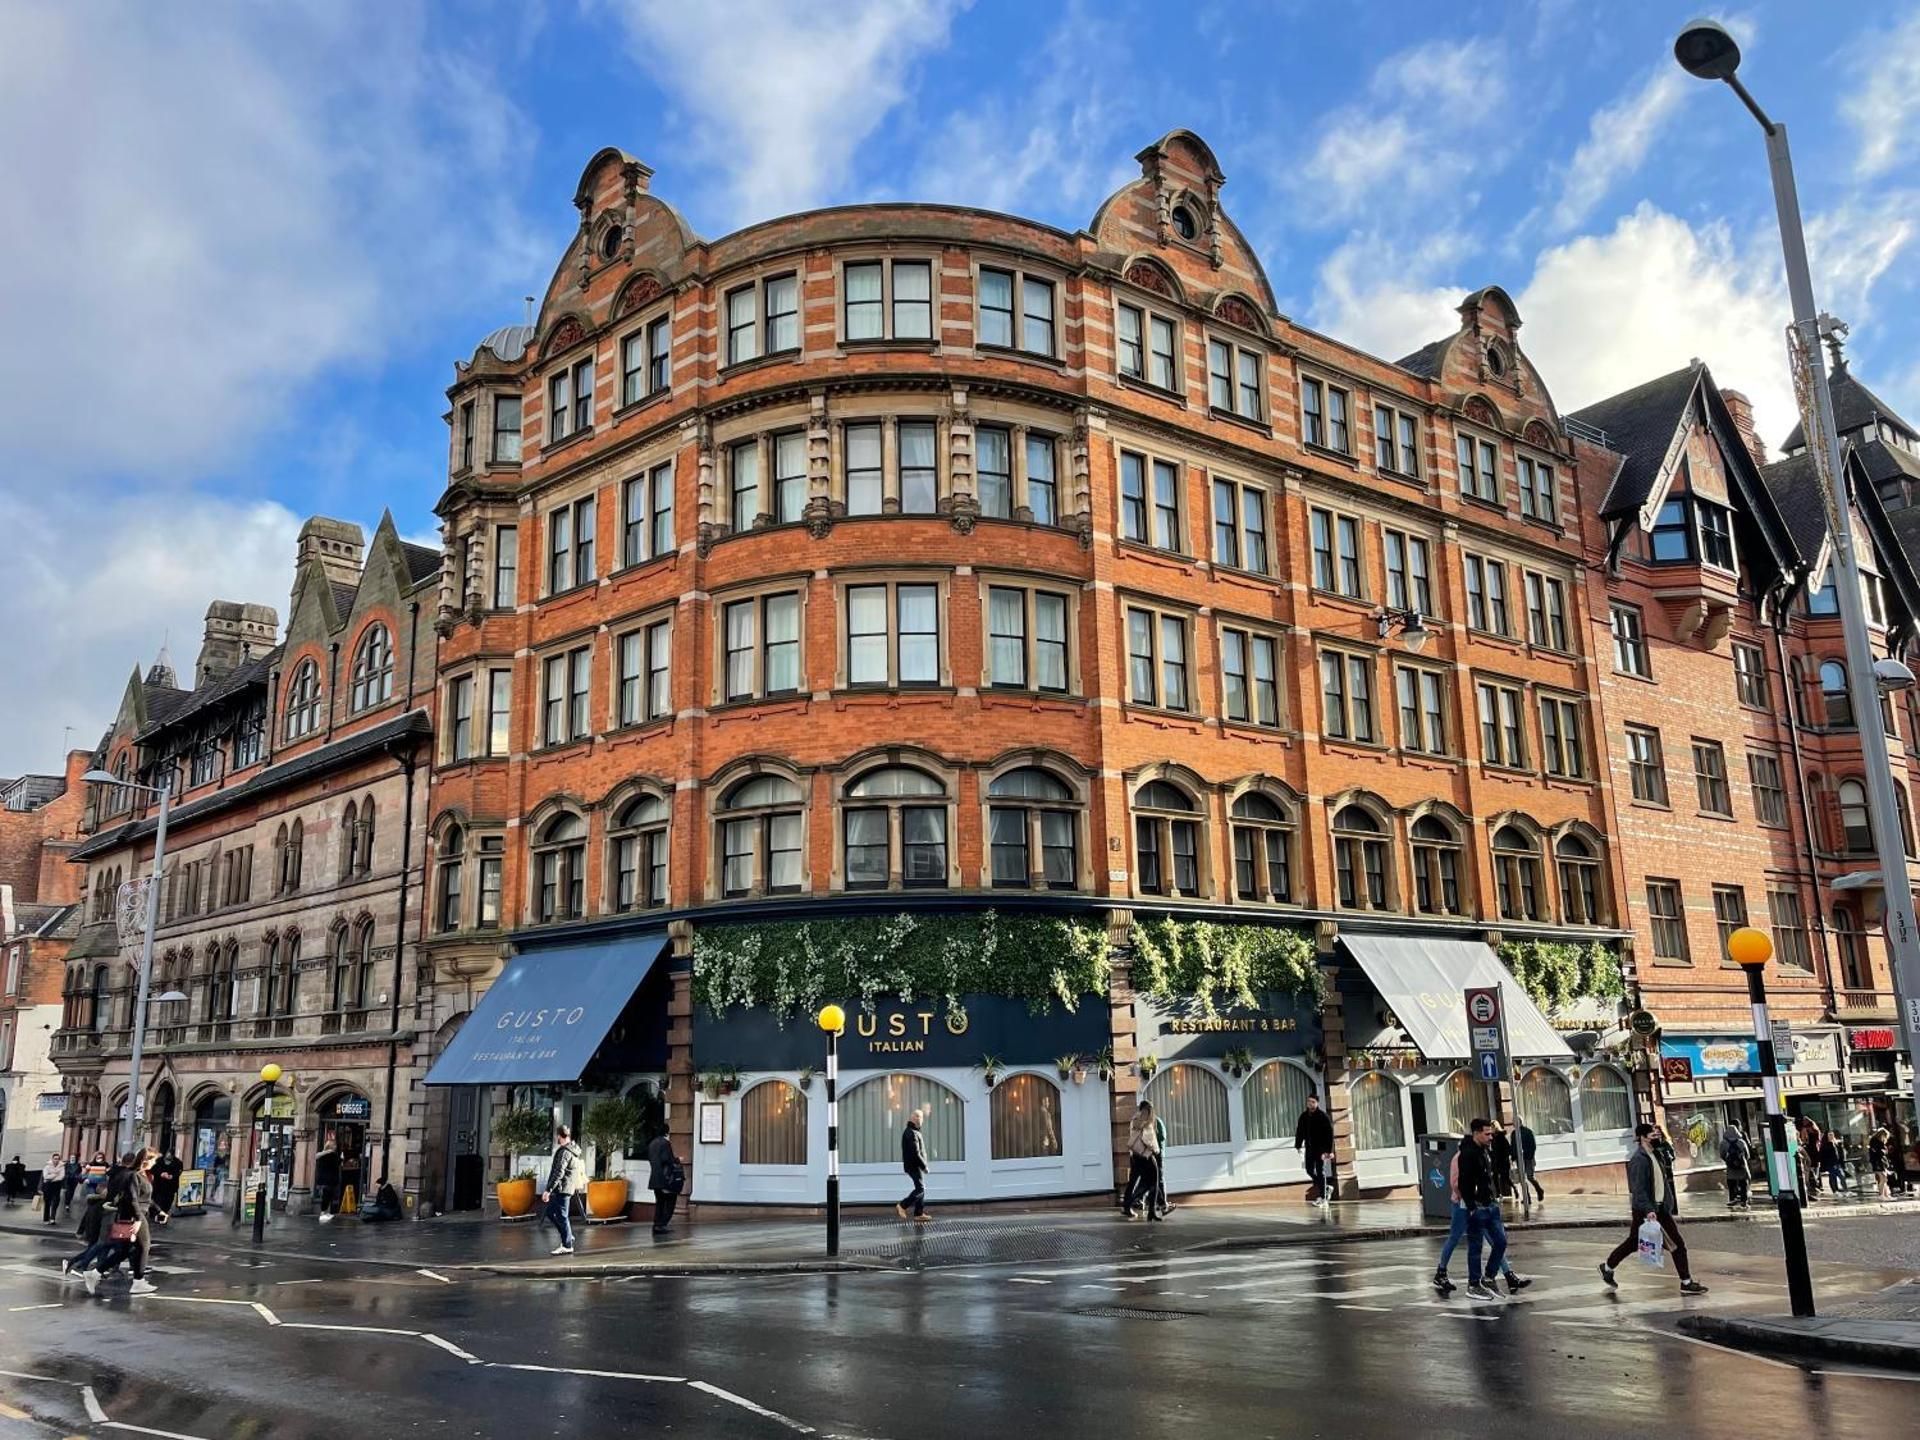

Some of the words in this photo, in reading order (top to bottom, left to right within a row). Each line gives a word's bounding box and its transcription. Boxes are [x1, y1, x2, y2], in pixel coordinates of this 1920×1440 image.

[497, 1006, 584, 1028] GUSTO
[835, 1013, 968, 1037] USTO
[1171, 1019, 1257, 1031] RESTAURANT
[1260, 1019, 1269, 1031] &
[1272, 1019, 1297, 1031] BAR
[869, 1041, 924, 1052] ITALIAN
